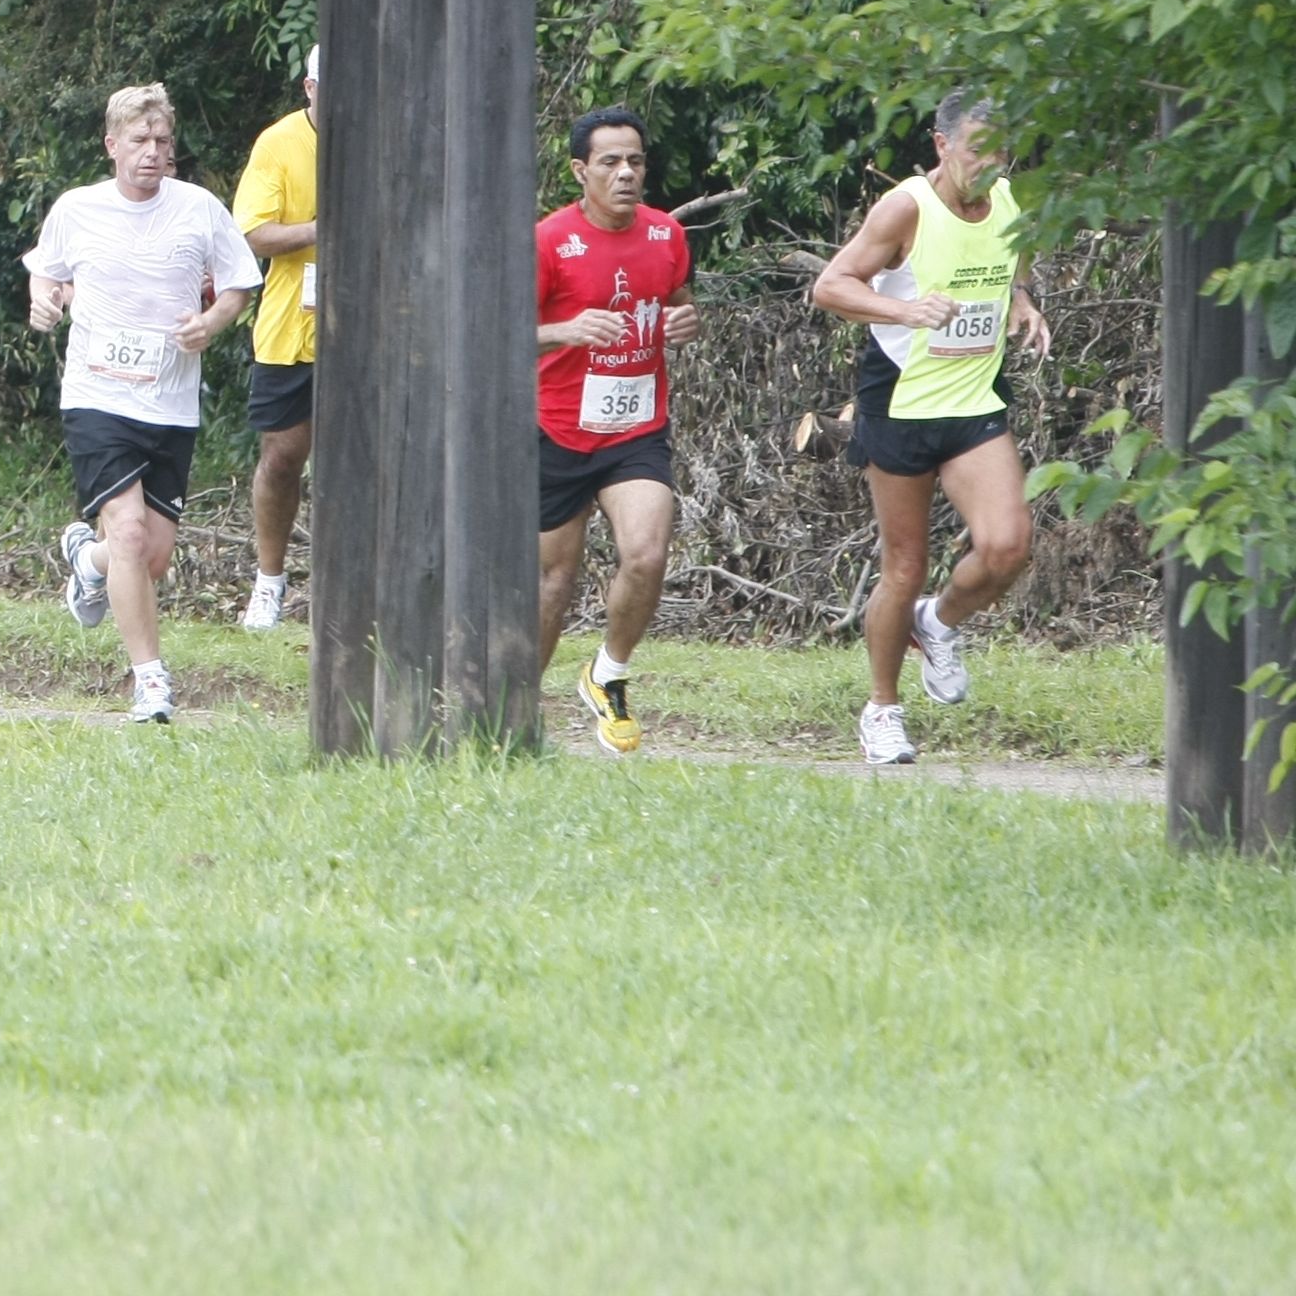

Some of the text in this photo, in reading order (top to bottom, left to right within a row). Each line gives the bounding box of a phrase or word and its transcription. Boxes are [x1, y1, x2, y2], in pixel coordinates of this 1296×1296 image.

[648, 225, 671, 240] Amil
[945, 316, 993, 338] 1058
[104, 343, 146, 366] 367
[588, 351, 628, 368] Tingui
[600, 394, 640, 415] 356
